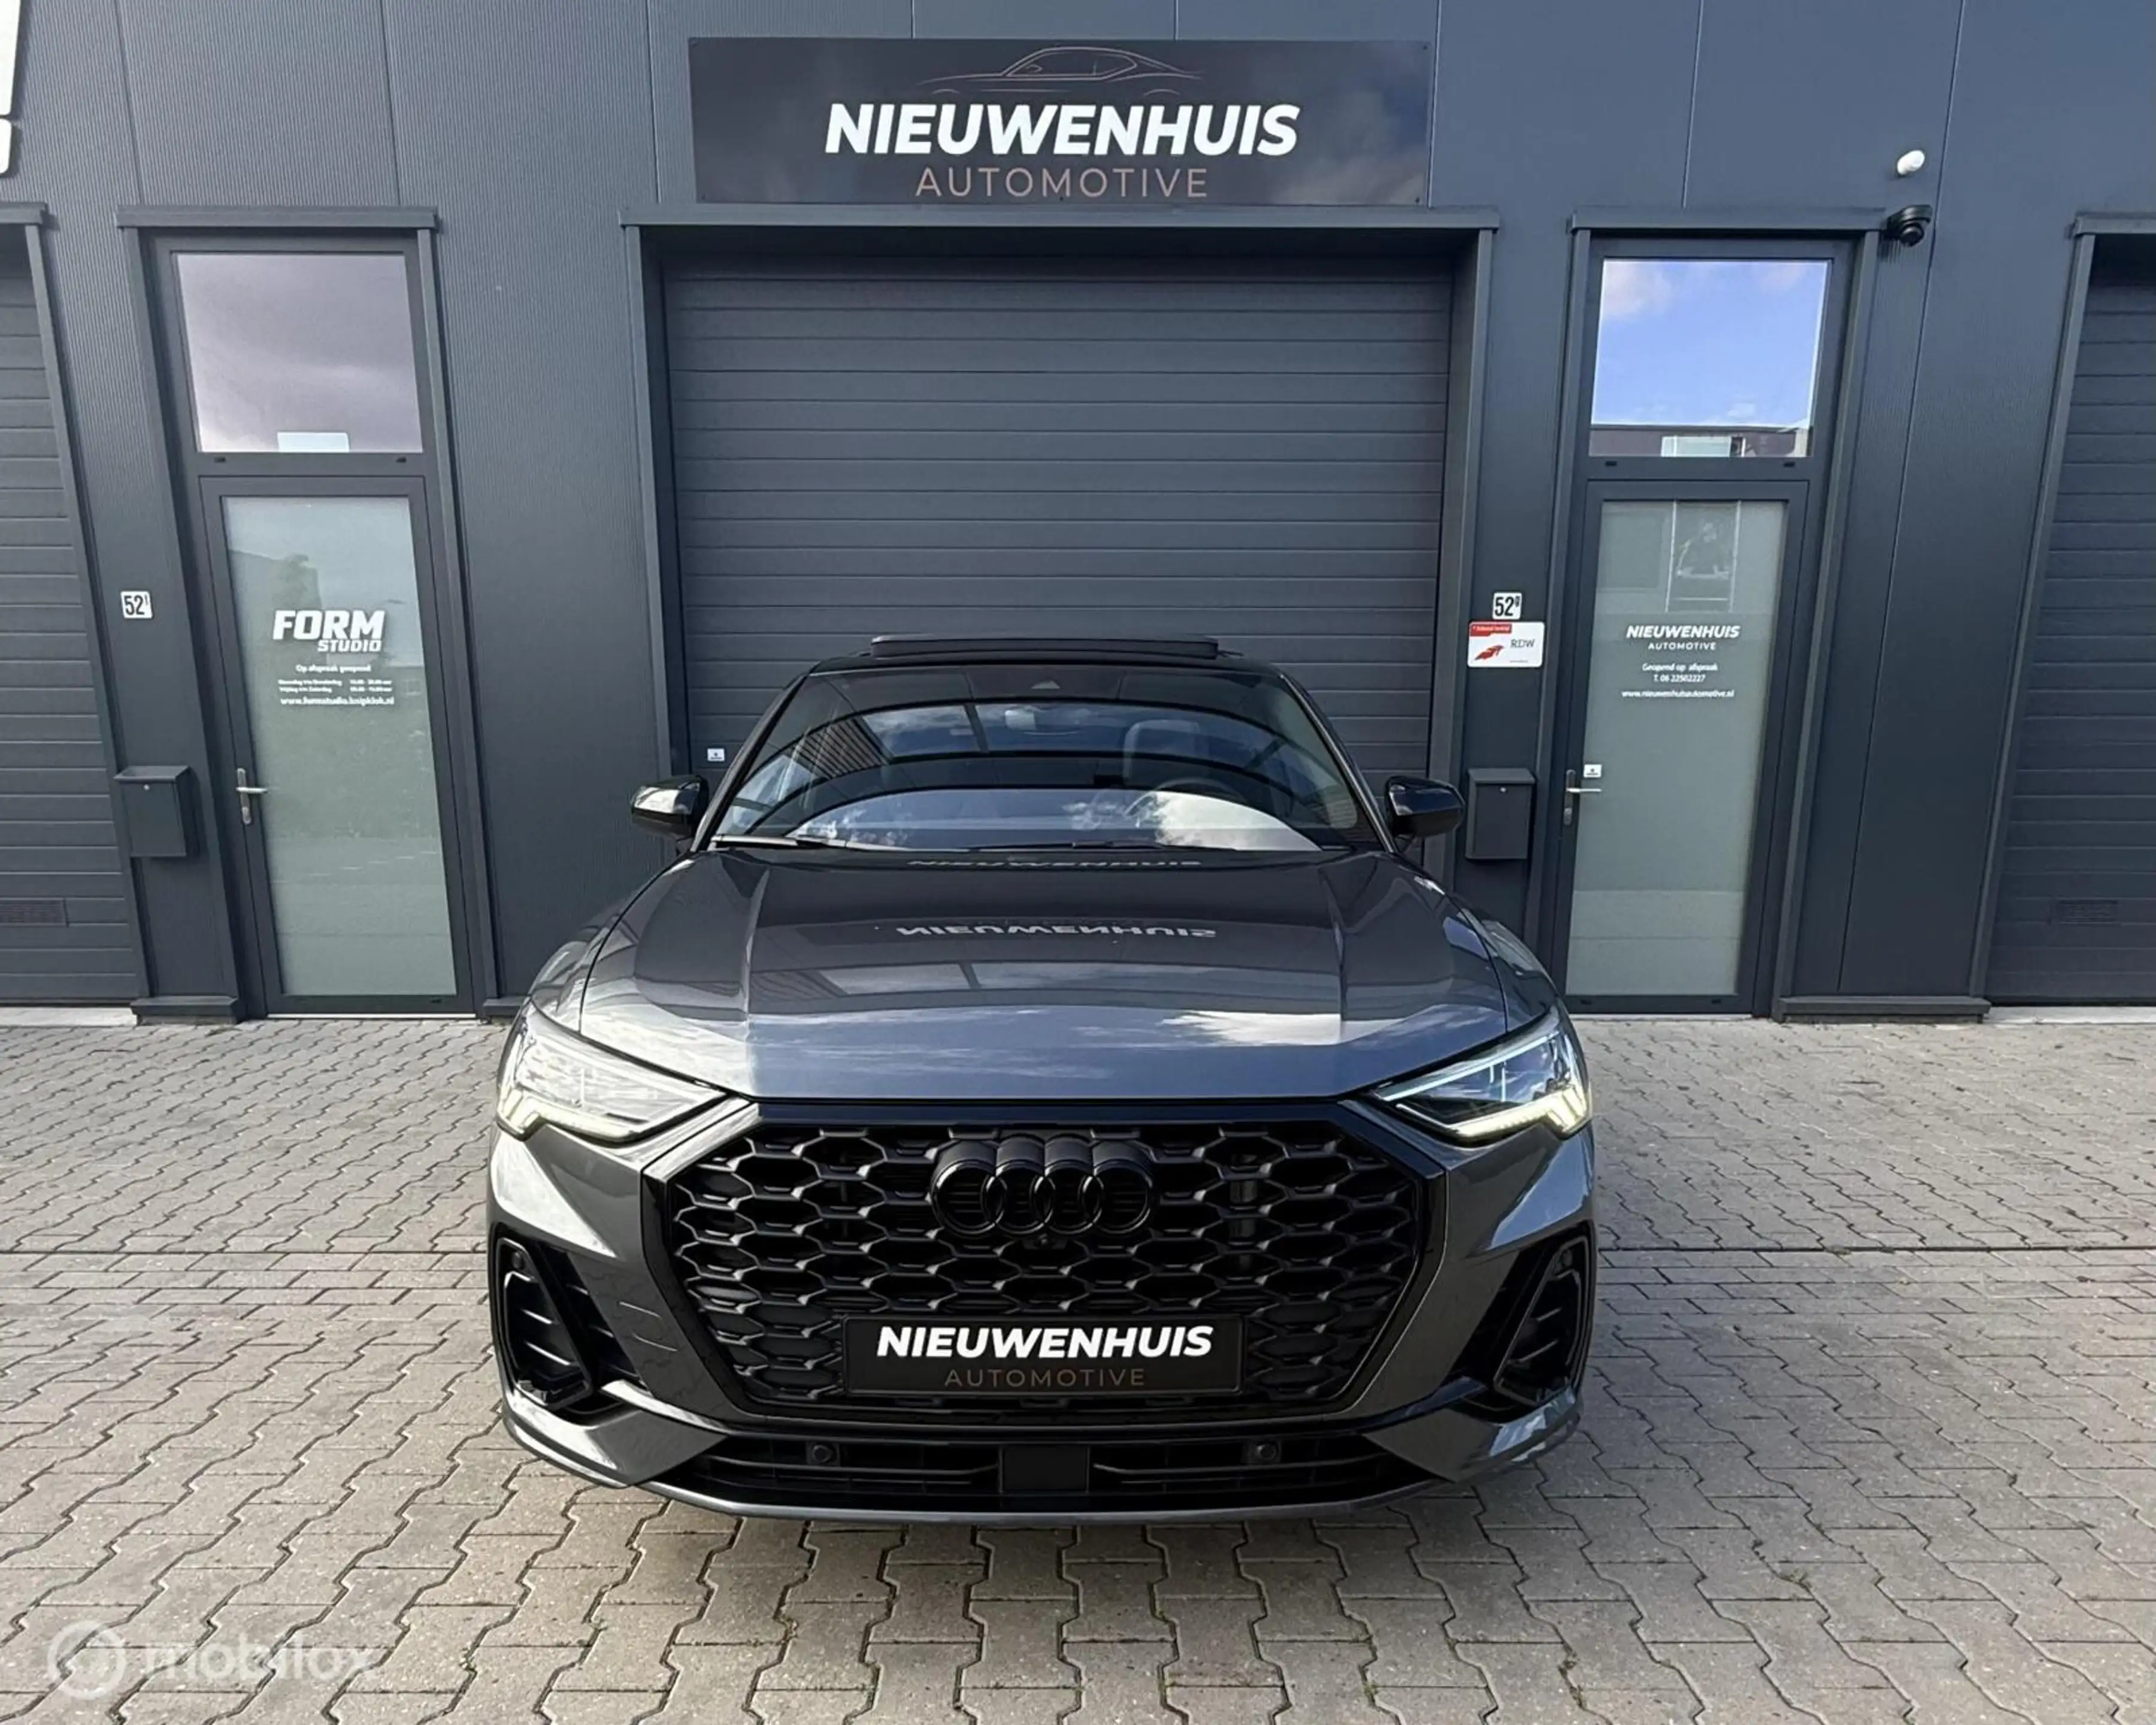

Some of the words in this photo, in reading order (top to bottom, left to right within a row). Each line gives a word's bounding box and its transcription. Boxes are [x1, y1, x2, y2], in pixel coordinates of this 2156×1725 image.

[825, 103, 1300, 156] NIEUWENHUIS
[916, 168, 1207, 197] AUTOMOTIVE
[272, 610, 385, 640] FORM
[1625, 625, 1741, 638] NIEUWENHUIS
[317, 640, 382, 652] STUDIO
[1648, 641, 1716, 650] AUTOMOTIVE
[876, 1325, 1213, 1358] NIEUWENHUIS
[944, 1369, 1145, 1387] AUTOMOTIVE
